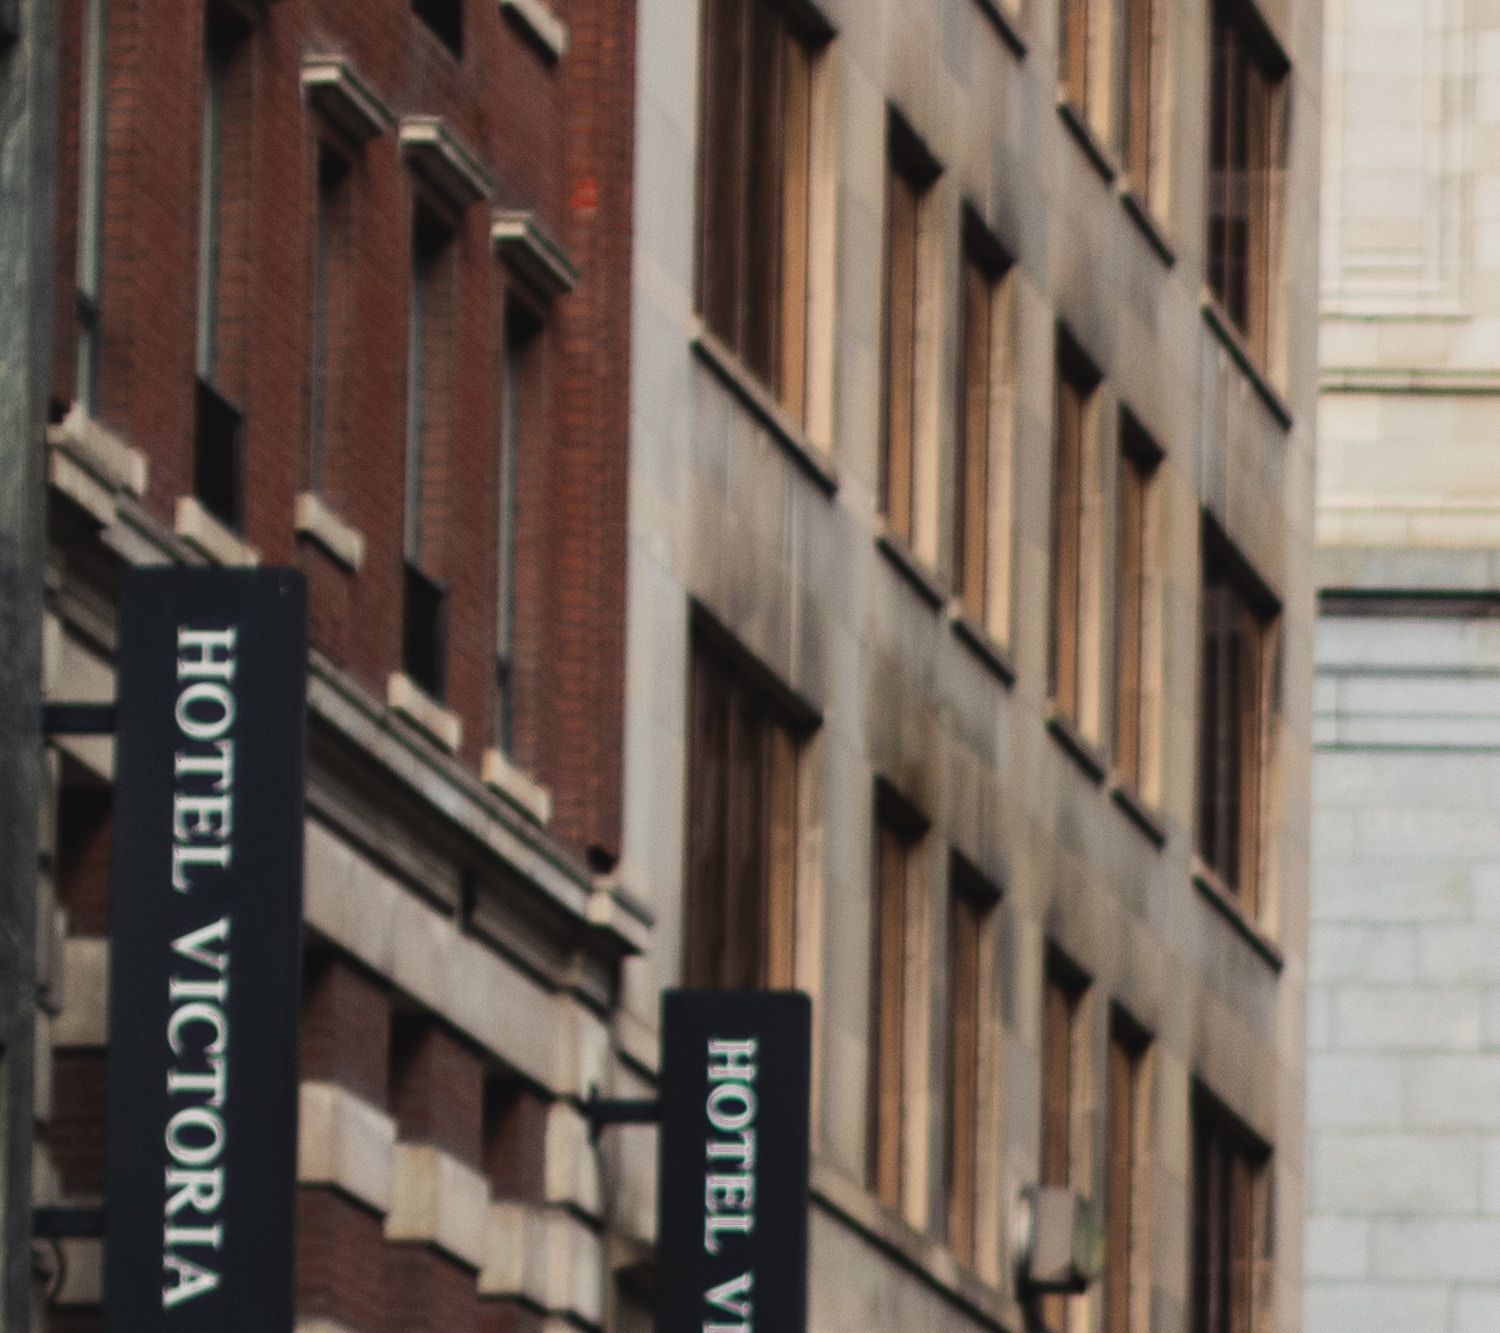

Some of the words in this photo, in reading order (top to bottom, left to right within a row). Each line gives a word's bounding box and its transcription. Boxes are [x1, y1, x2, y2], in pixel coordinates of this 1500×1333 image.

[171, 627, 237, 892] HOTEL
[161, 917, 230, 1307] VICTORIA
[704, 1038, 758, 1254] HOTEL
